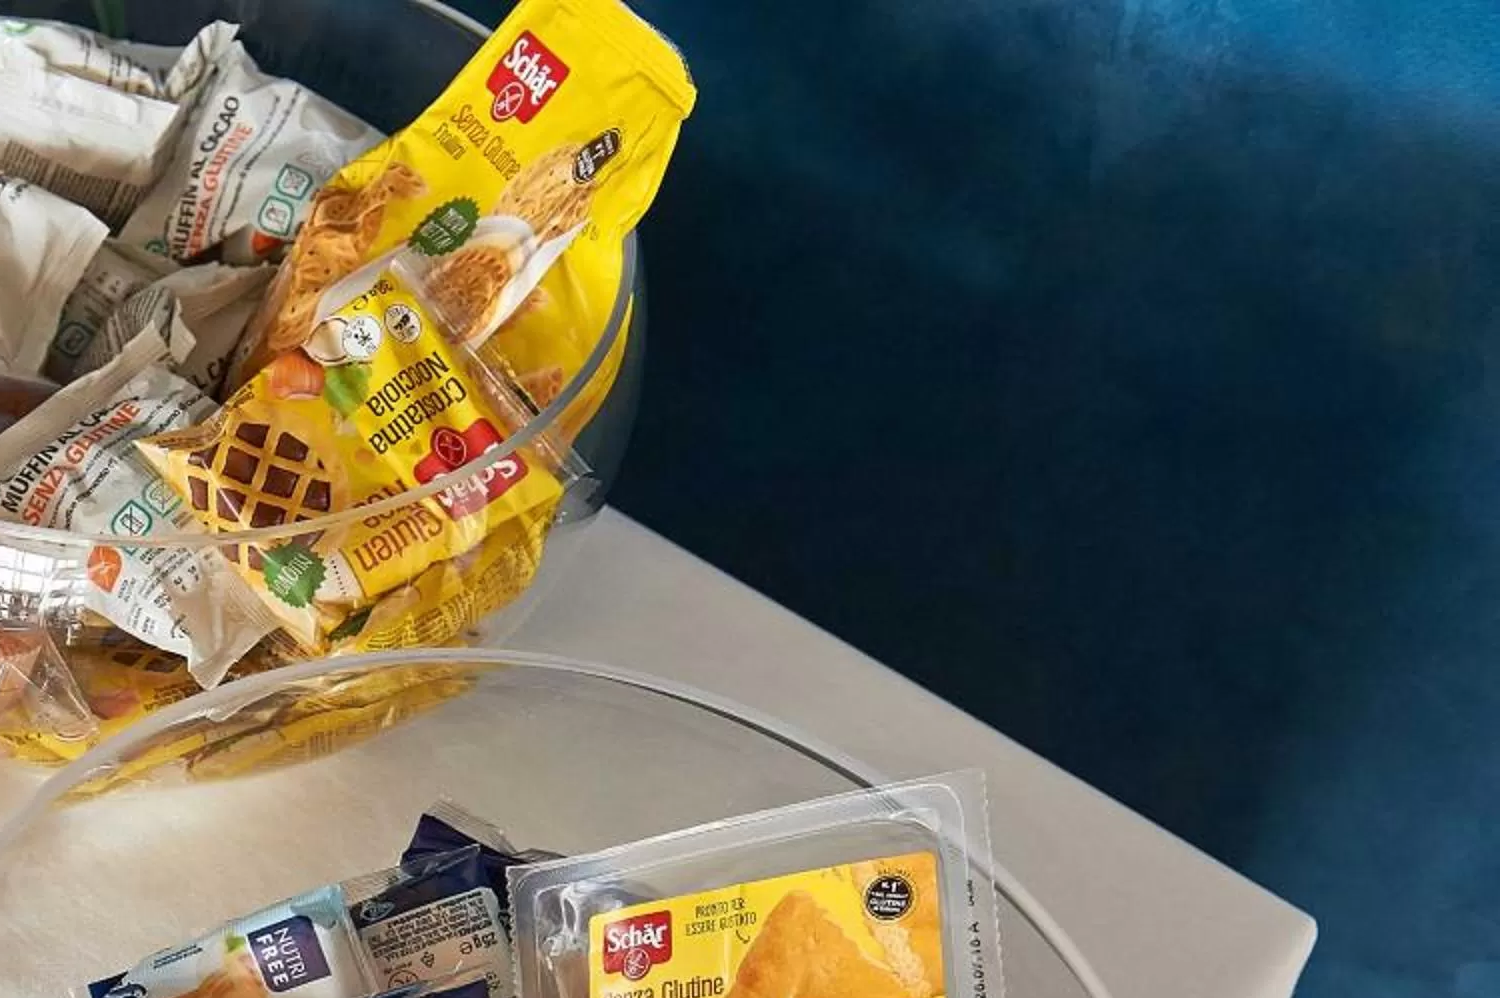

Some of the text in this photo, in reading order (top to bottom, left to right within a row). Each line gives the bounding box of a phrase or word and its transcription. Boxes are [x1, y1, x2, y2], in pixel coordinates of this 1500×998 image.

[503, 36, 557, 106] Schär
[191, 154, 206, 178] AL
[201, 95, 240, 153] CACAO
[201, 121, 252, 192] GLUTINE
[366, 351, 450, 417] Nocciola
[369, 376, 467, 456] Crostatina
[66, 400, 141, 464] GLUTINE
[1, 444, 60, 513] MUFFIN
[354, 509, 443, 570] Gluten
[254, 934, 290, 987] FREE
[274, 927, 311, 979] NUTRI
[606, 922, 668, 954] Schär
